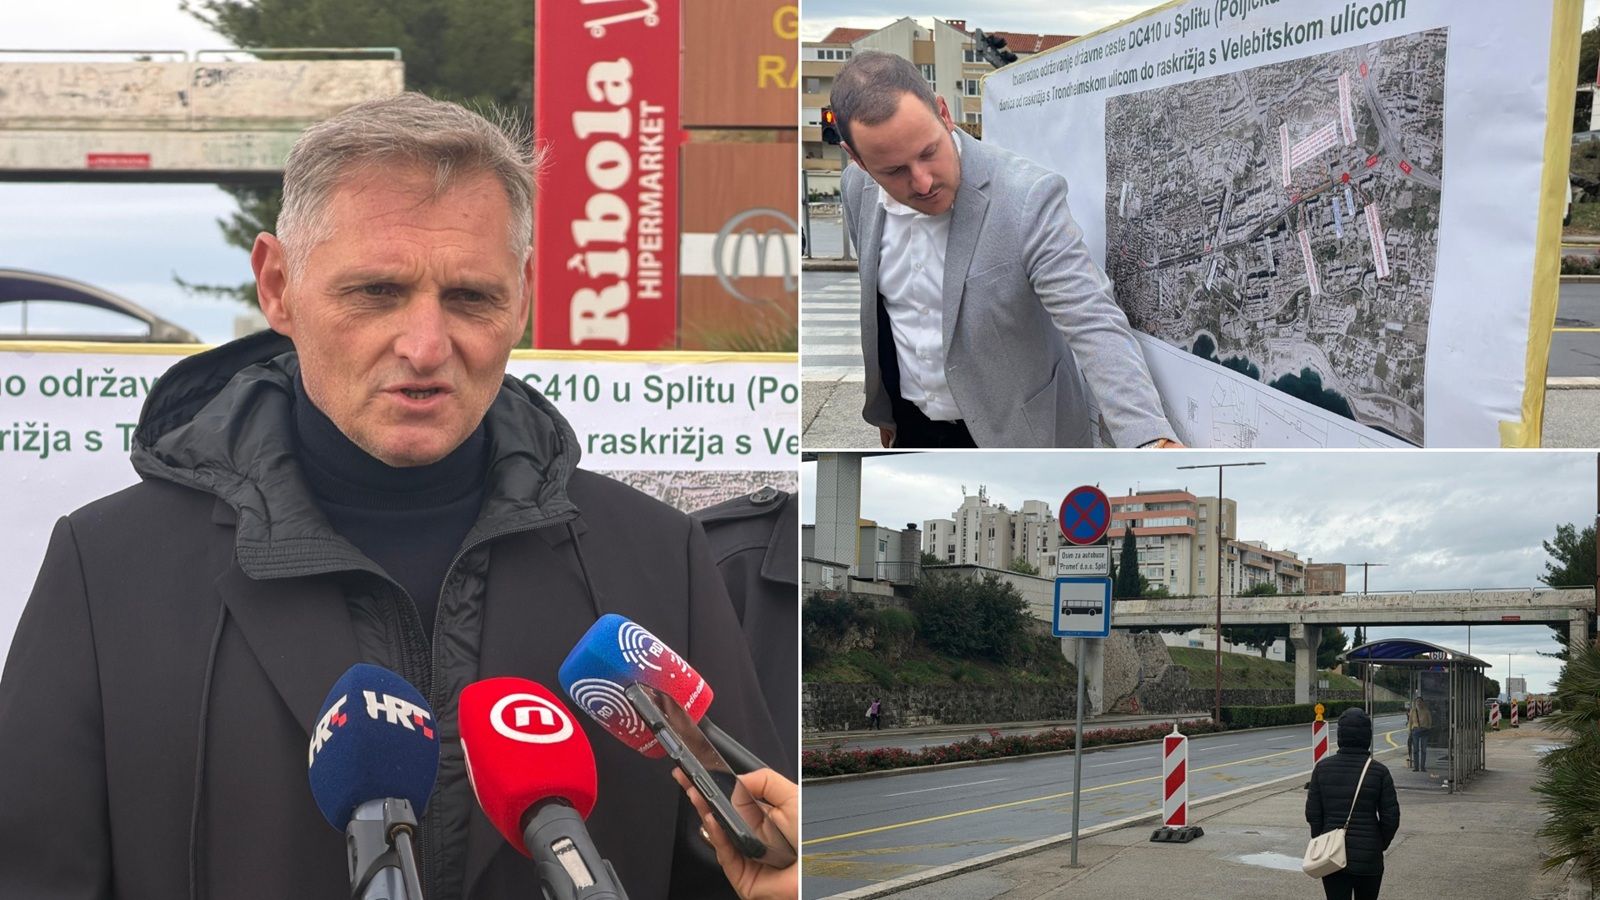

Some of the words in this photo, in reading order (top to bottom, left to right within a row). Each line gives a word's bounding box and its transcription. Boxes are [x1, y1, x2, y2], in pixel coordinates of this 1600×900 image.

[1023, 89, 1046, 106] raskrižja
[1052, 75, 1107, 101] Trondheimskom
[1108, 67, 1138, 88] ulicom
[1141, 61, 1154, 80] do
[1157, 47, 1205, 74] raskrižja
[1209, 47, 1217, 65] s
[1221, 18, 1324, 62] Velebitskom
[1331, 0, 1406, 36] ulicom
[1040, 54, 1073, 74] održavanje
[1074, 45, 1103, 67] državne
[1105, 36, 1126, 57] ceste
[1128, 21, 1161, 49] DC410
[1164, 22, 1171, 38] u
[1174, 7, 1210, 38] Splitu
[568, 57, 633, 346] Ribola
[637, 100, 665, 299] HIPERMARKET
[613, 382, 630, 402] u
[643, 375, 735, 410] Splitu
[84, 430, 103, 452] s
[587, 427, 724, 462] raskrižja
[735, 434, 752, 455] s
[363, 689, 434, 740] HRT
